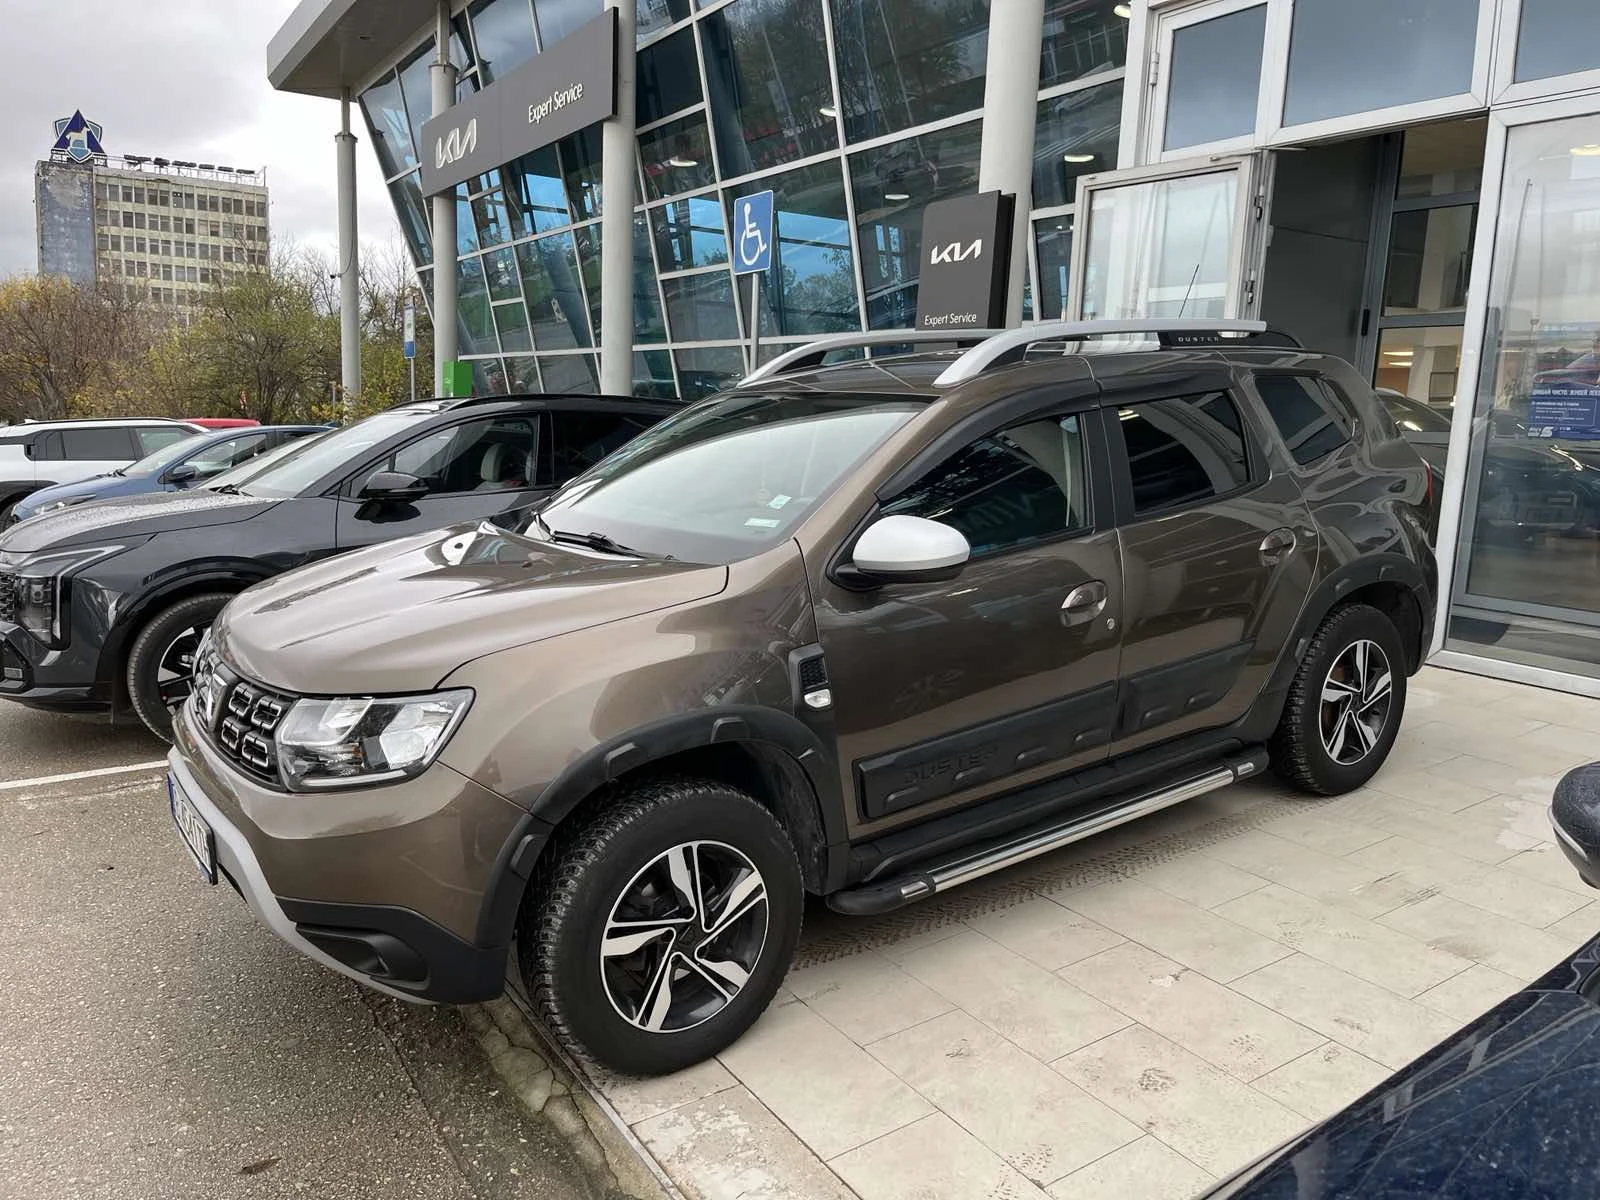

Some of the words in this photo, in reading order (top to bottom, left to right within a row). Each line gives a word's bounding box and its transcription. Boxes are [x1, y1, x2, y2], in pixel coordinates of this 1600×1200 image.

[528, 96, 552, 123] Expert
[553, 82, 583, 110] Service
[924, 314, 948, 327] Expert
[949, 312, 977, 324] Service
